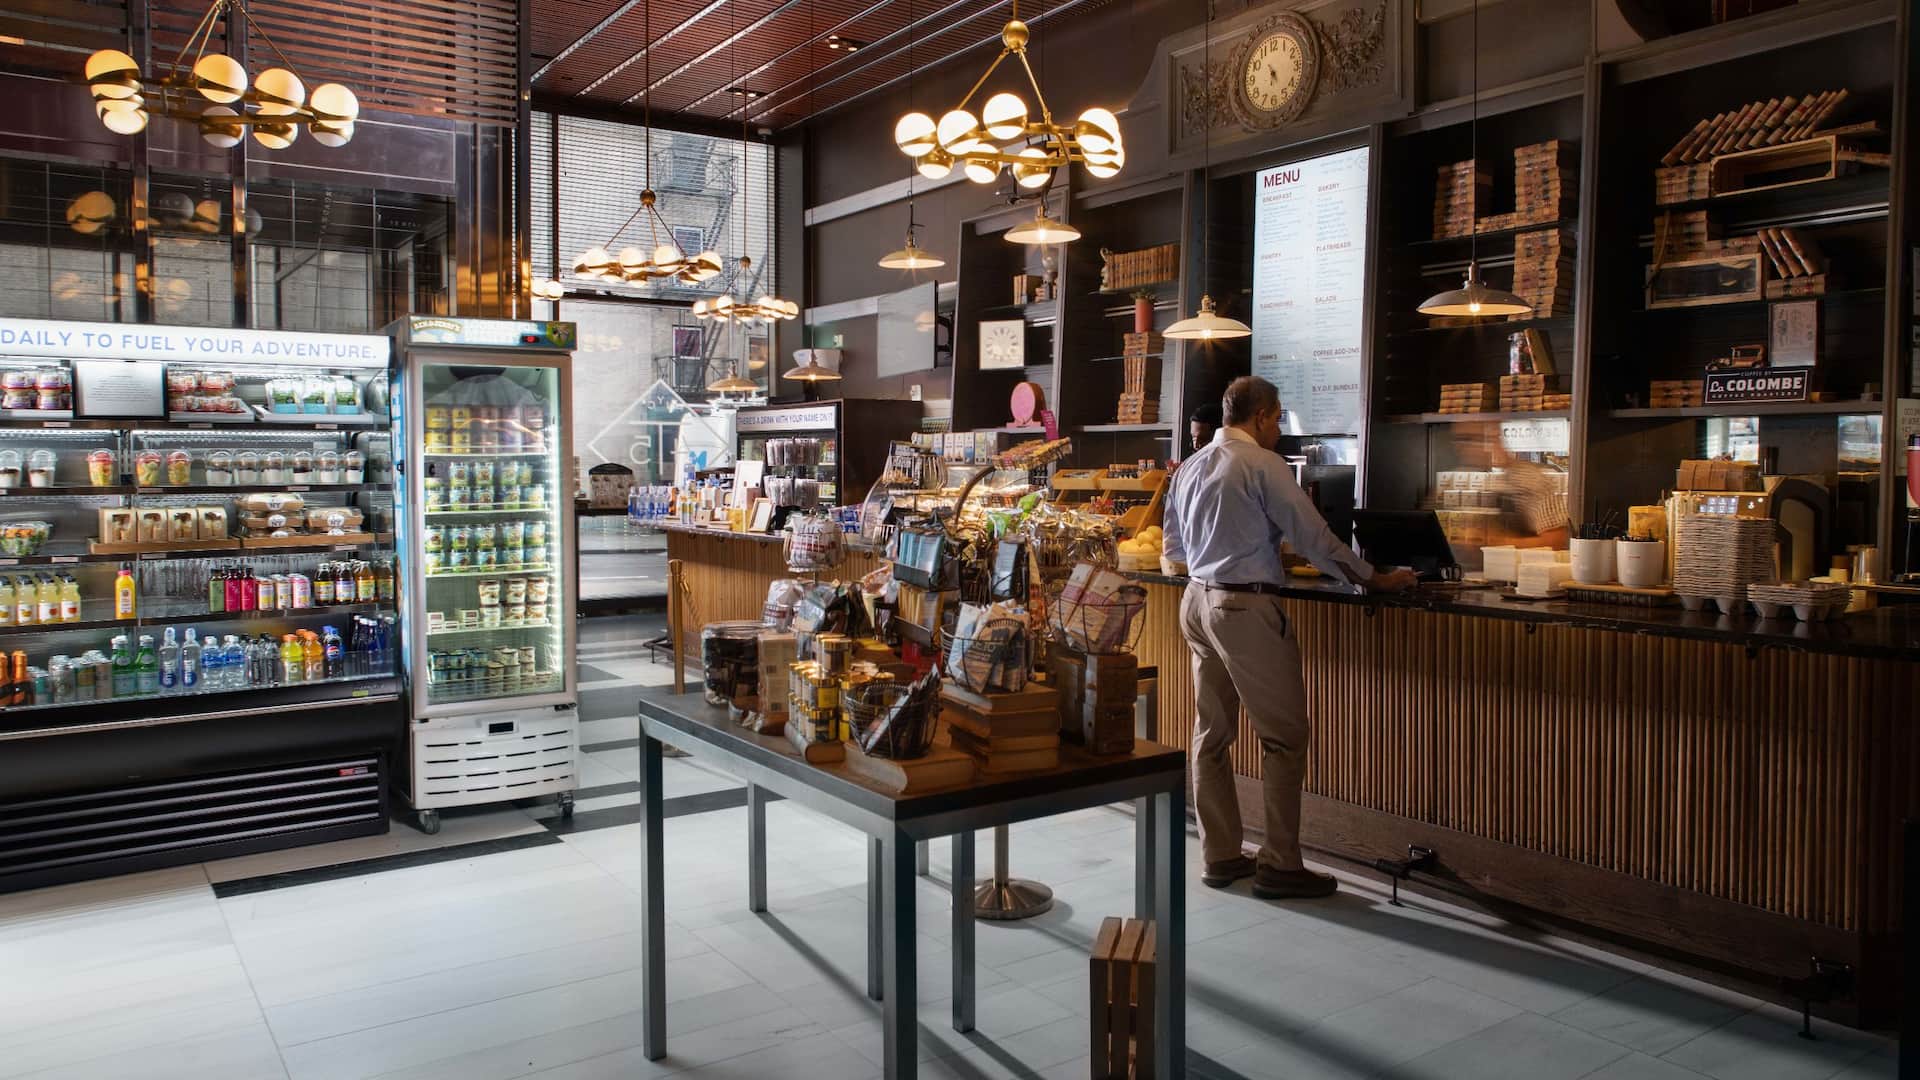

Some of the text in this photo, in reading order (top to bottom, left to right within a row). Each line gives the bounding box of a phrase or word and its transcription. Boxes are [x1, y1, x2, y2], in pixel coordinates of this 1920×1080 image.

[1270, 40, 1278, 52] 12
[1260, 46, 1266, 60] 11
[1290, 48, 1296, 59] 2
[1253, 60, 1261, 72] 10
[1293, 60, 1299, 72] 3
[1249, 75, 1255, 86] 9
[1288, 76, 1294, 87] 4
[1253, 88, 1259, 98] 8
[1281, 88, 1288, 100] 5
[1262, 94, 1268, 106] 7
[1271, 95, 1278, 106] 6
[1264, 168, 1300, 188] MENU
[1, 329, 376, 359] DAILY TO FUEL YOUR ADVENTURE.
[1710, 376, 1803, 392] La COLOMBE
[776, 415, 788, 423] WITH
[789, 414, 803, 423] YOUR
[804, 413, 819, 422] NAME
